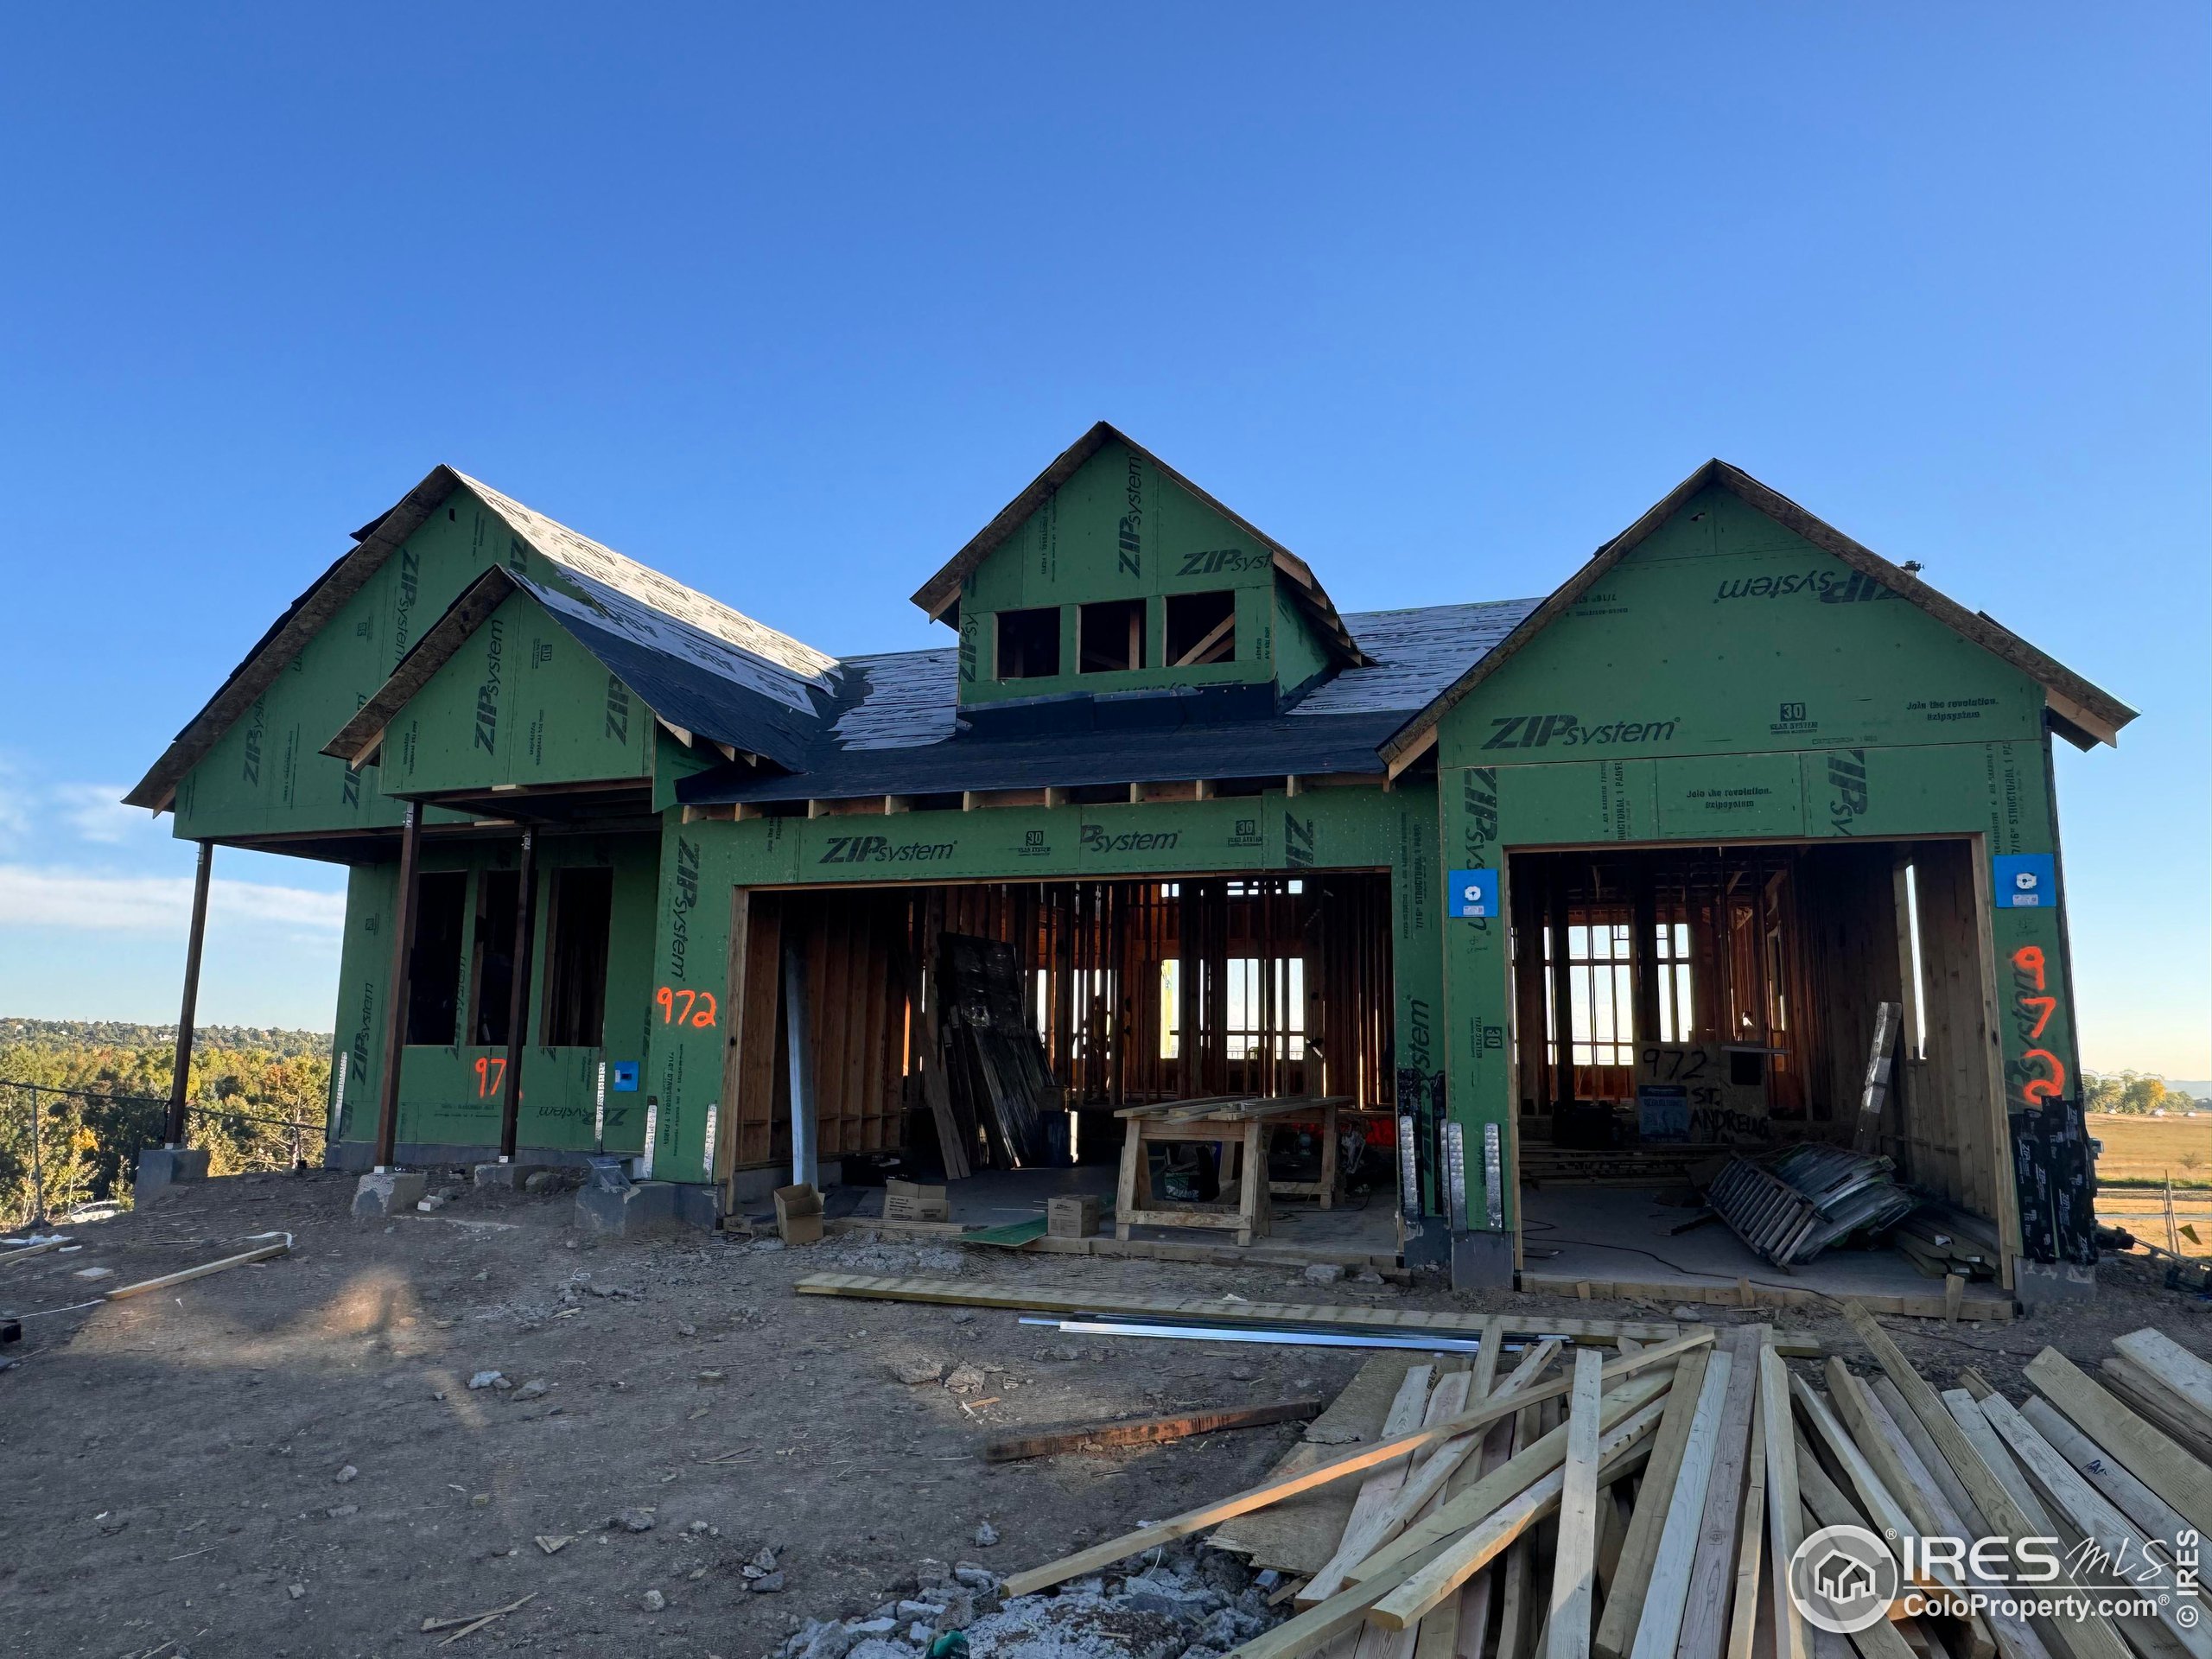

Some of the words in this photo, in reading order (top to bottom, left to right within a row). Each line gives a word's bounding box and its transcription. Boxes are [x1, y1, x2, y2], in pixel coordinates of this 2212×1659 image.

[1119, 455, 1142, 580] ZIPsystem
[475, 619, 504, 756] ZIPsystem
[1780, 702, 1807, 721] 30
[1480, 715, 1681, 750] ZIPsystem
[818, 836, 957, 863] ZIPsystem
[671, 835, 700, 980] ZIPsystem
[656, 986, 717, 1027] 972
[2012, 945, 2065, 1105] 972
[1643, 1048, 1707, 1080] 972
